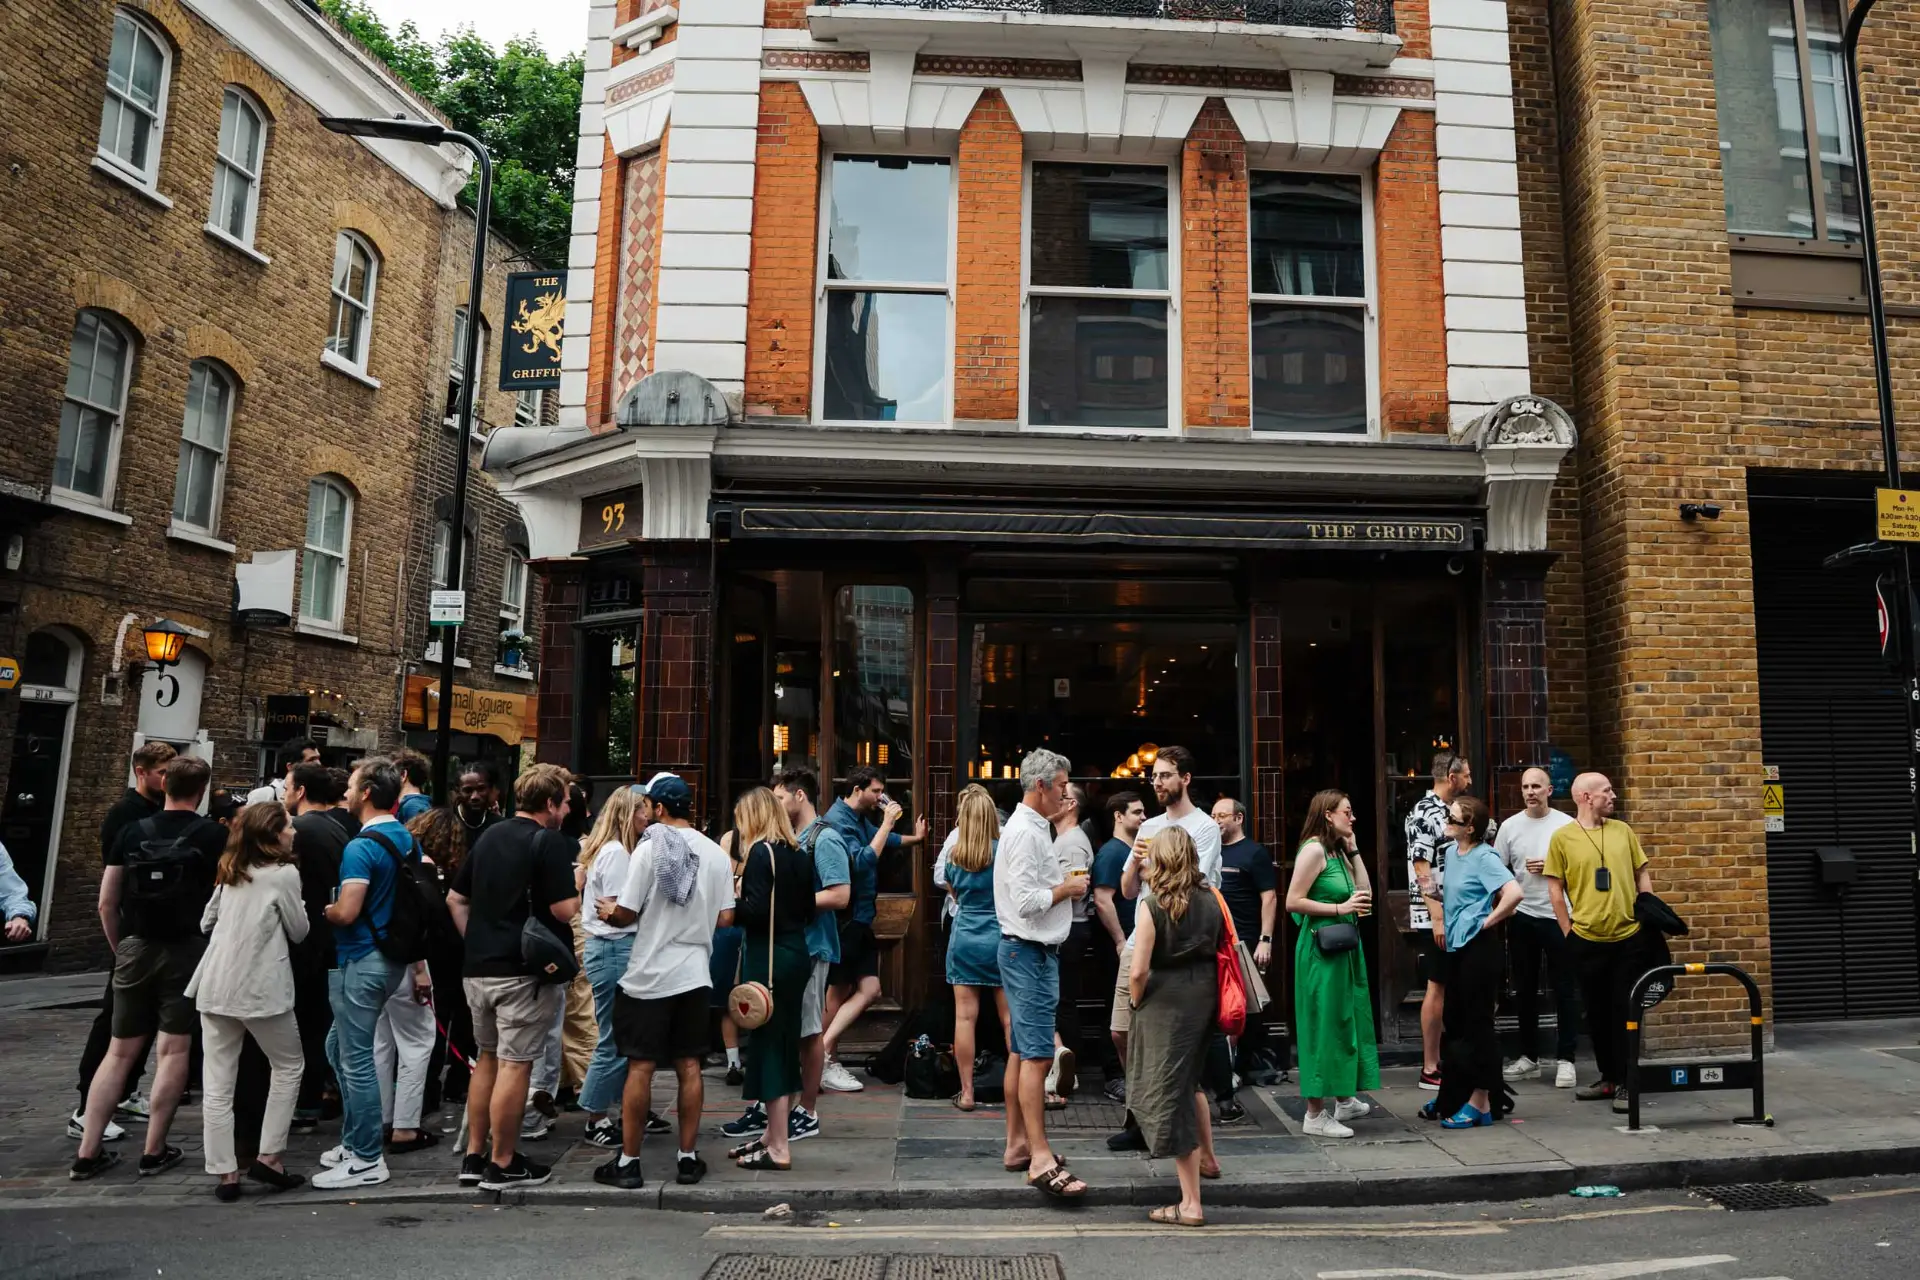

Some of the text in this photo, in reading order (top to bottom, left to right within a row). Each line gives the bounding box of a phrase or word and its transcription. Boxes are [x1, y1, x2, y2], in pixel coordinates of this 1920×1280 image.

[533, 277, 559, 287] THE
[602, 502, 625, 533] 93
[1307, 524, 1457, 540] THE GRIFFIN
[1892, 522, 1918, 530] Saturday
[0, 669, 15, 679] ADT
[478, 696, 513, 717] square
[267, 711, 306, 725] Home
[1675, 1069, 1685, 1083] P
